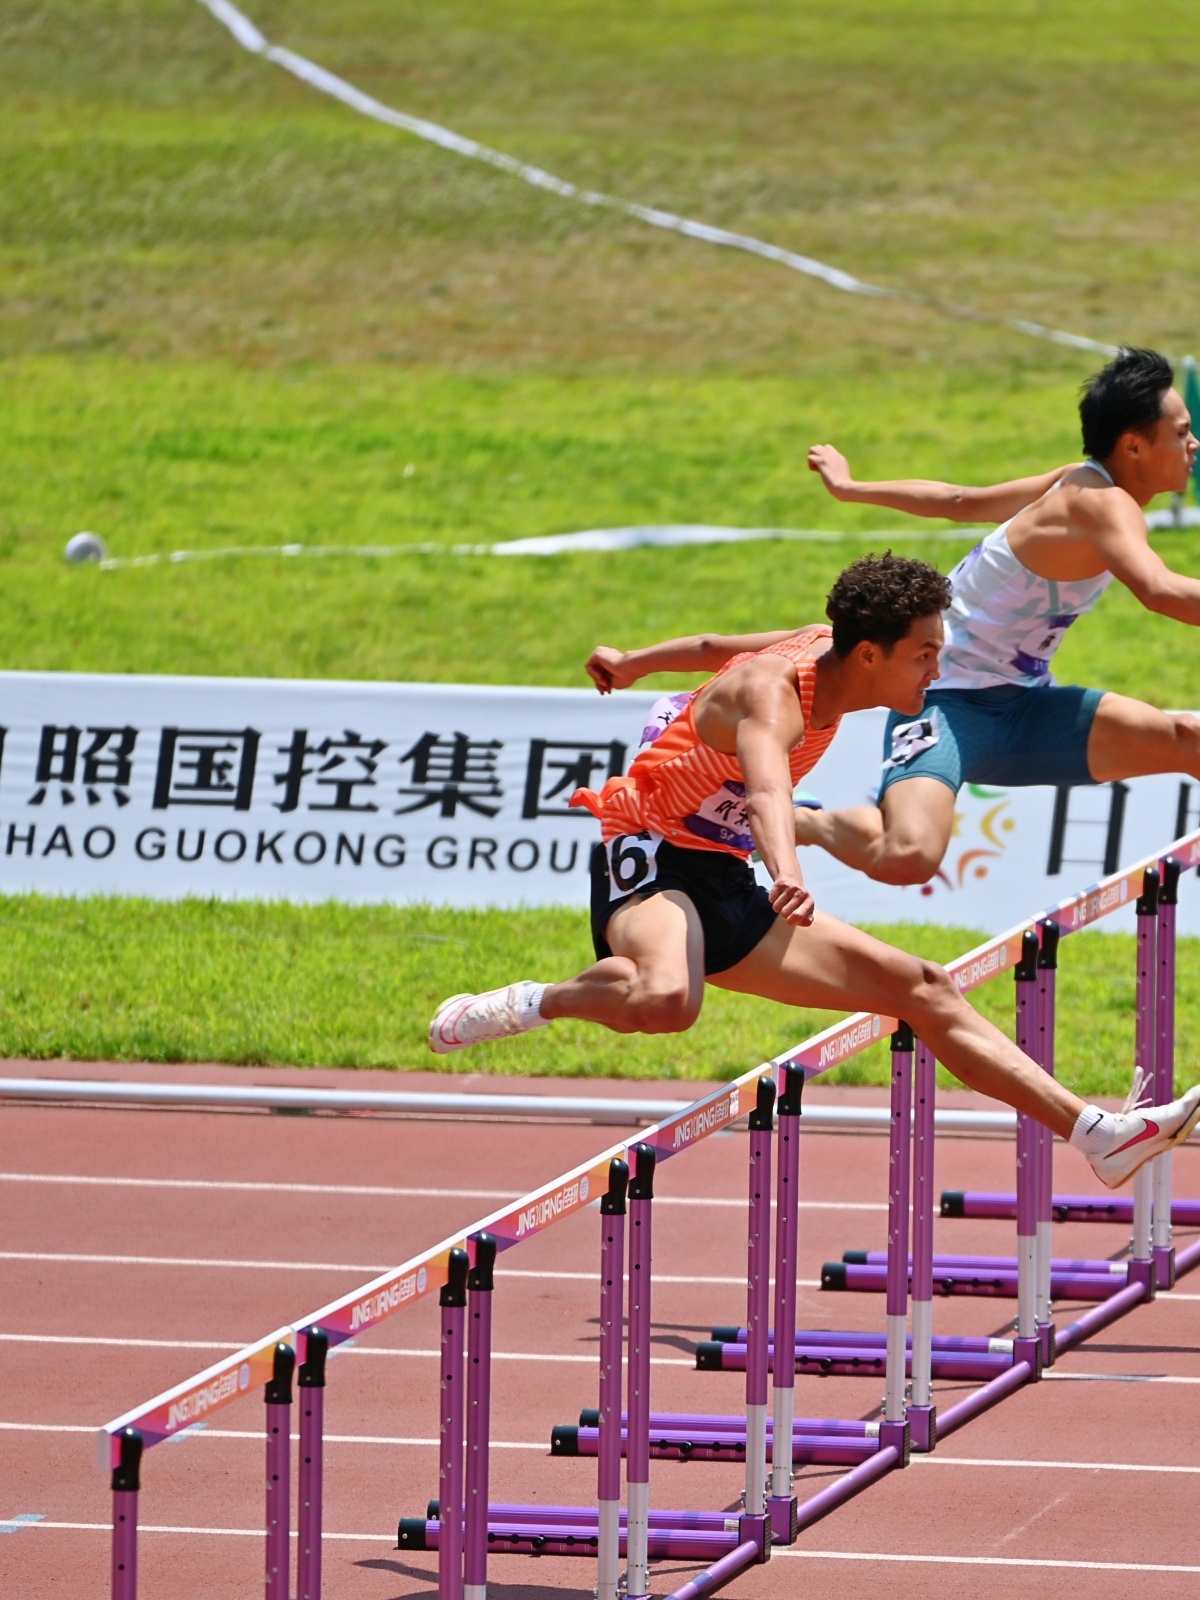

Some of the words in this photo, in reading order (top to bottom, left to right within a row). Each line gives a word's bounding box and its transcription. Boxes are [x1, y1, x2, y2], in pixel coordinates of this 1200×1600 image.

[0, 724, 628, 820] 照国控集团
[0, 823, 116, 860] HAO
[135, 826, 406, 868] GUOKONG
[427, 836, 601, 873] GROU
[611, 831, 653, 892] 6
